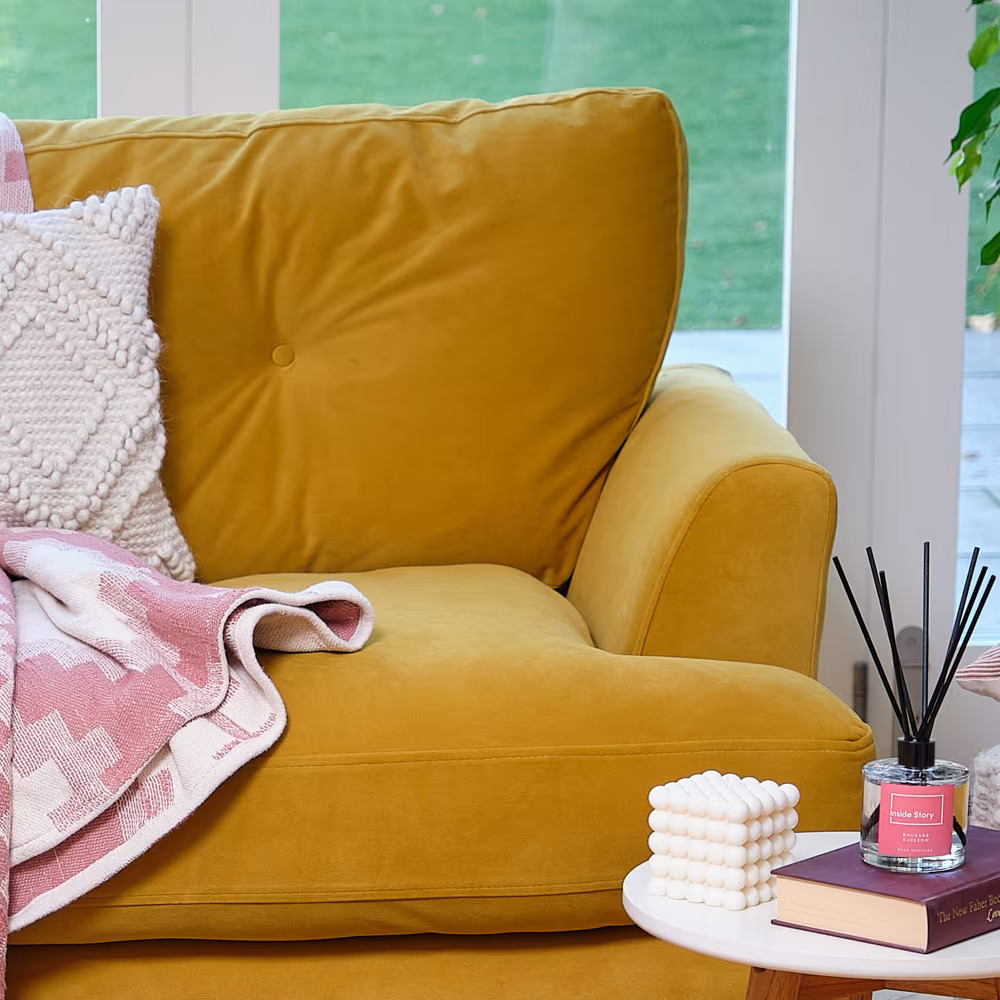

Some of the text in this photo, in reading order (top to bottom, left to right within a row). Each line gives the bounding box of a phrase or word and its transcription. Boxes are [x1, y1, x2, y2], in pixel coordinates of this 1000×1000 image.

[890, 809, 934, 819] Inside Story
[937, 912, 951, 923] The
[952, 906, 968, 918] New
[969, 899, 987, 912] Faber
